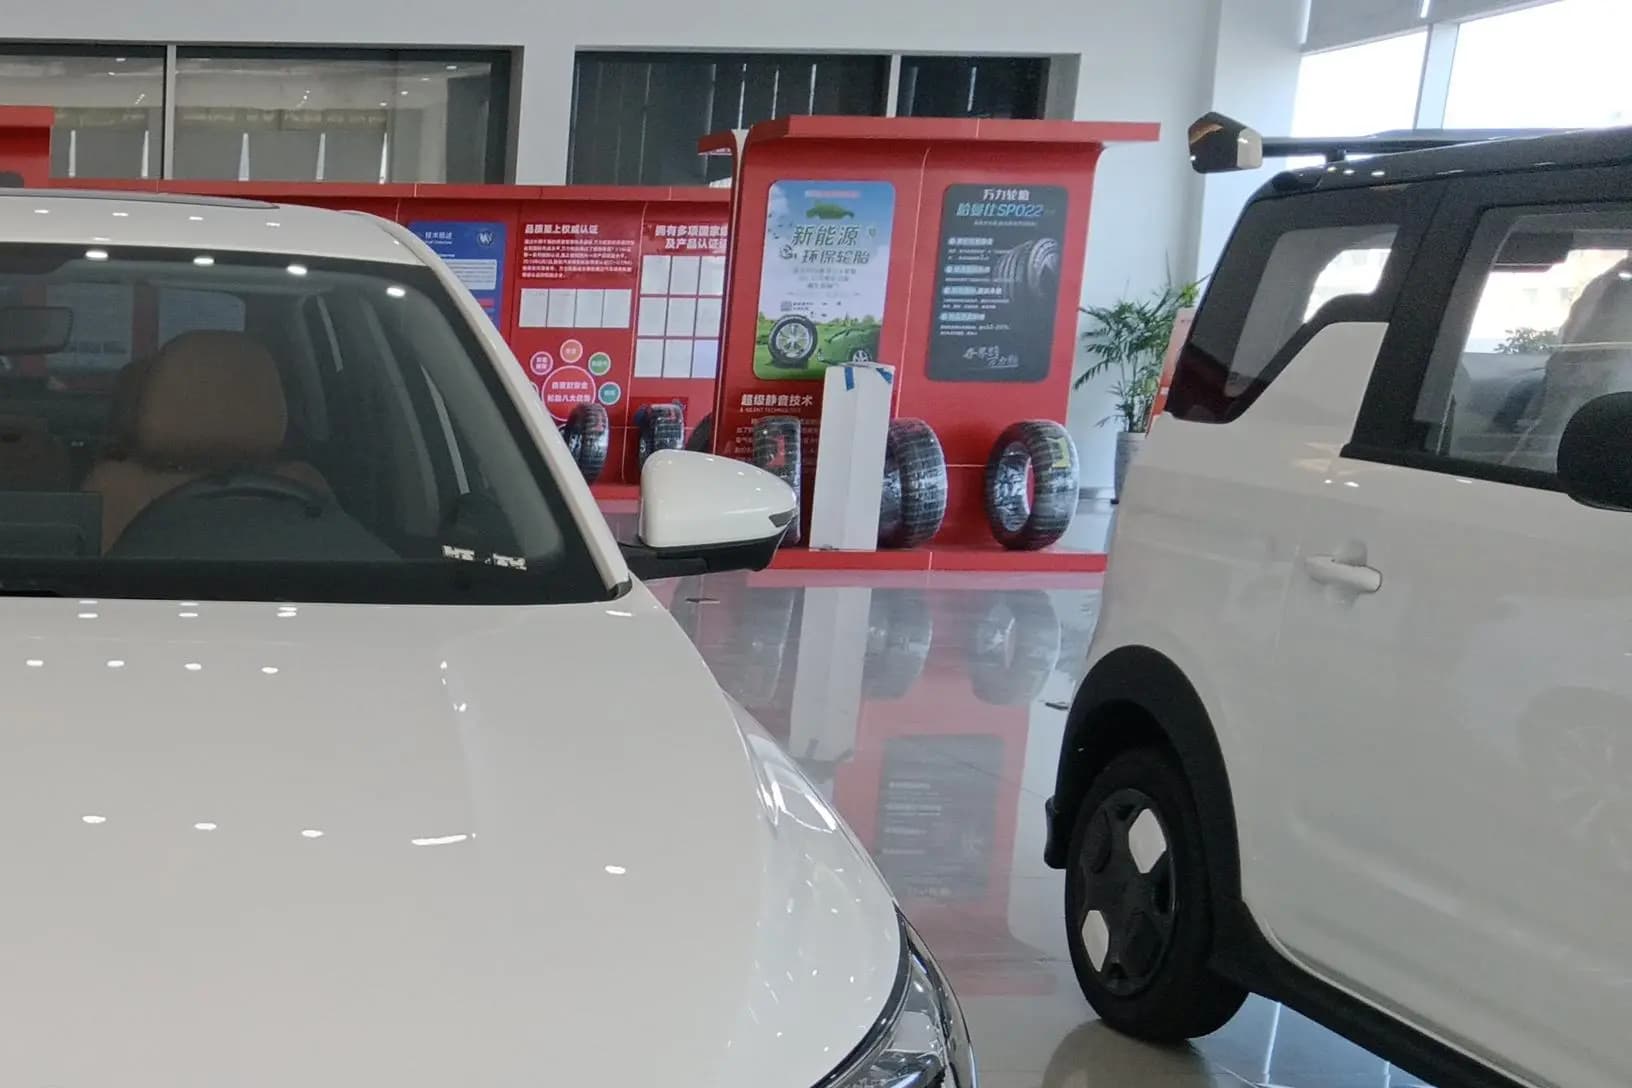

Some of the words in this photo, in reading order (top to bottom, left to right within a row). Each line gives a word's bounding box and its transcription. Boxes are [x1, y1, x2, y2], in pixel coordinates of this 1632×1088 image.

[983, 188, 1031, 201] 万力轮胎
[791, 225, 860, 246] 新能源
[801, 249, 871, 265] 环保轮胎
[741, 394, 813, 406] 超级静音技术
